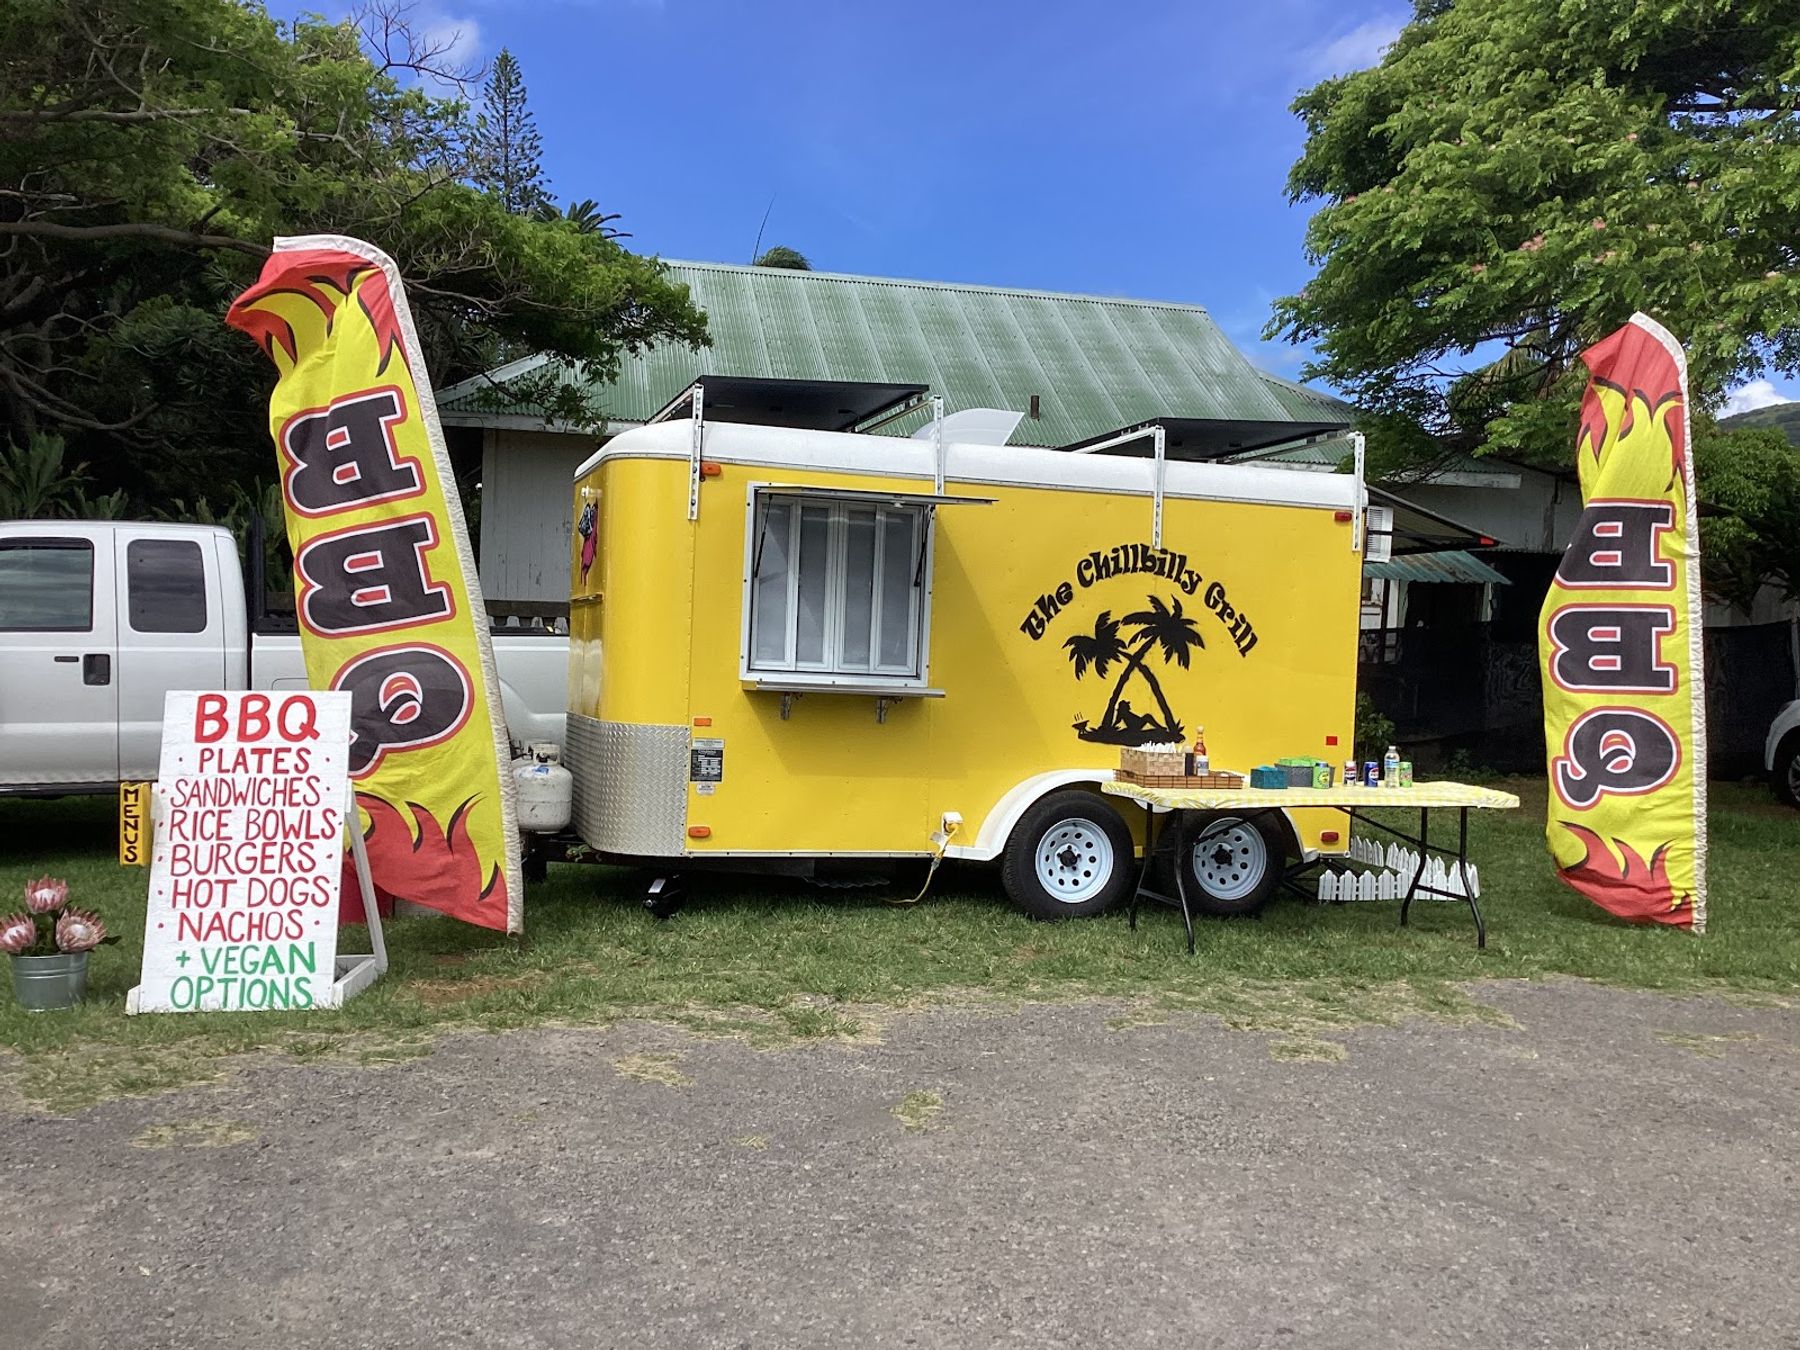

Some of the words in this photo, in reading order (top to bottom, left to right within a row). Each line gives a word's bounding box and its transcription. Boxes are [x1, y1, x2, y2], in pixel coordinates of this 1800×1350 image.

[1020, 581, 1073, 641] The
[1077, 543, 1203, 595] Chillbilly
[1204, 581, 1258, 658] Grill
[194, 693, 320, 743] BBQ
[199, 747, 312, 774] PLATES
[170, 776, 321, 808] SANDWICHES
[123, 788, 140, 863] MENUS
[169, 809, 233, 841] RICE
[245, 808, 337, 840] BOWLS
[170, 842, 316, 876] BURGERS
[171, 878, 238, 908] HOT
[247, 876, 331, 908] DOGS
[178, 909, 304, 941] NACHOS
[200, 942, 316, 975] VEGAN
[170, 976, 313, 1010] OPTIONS
